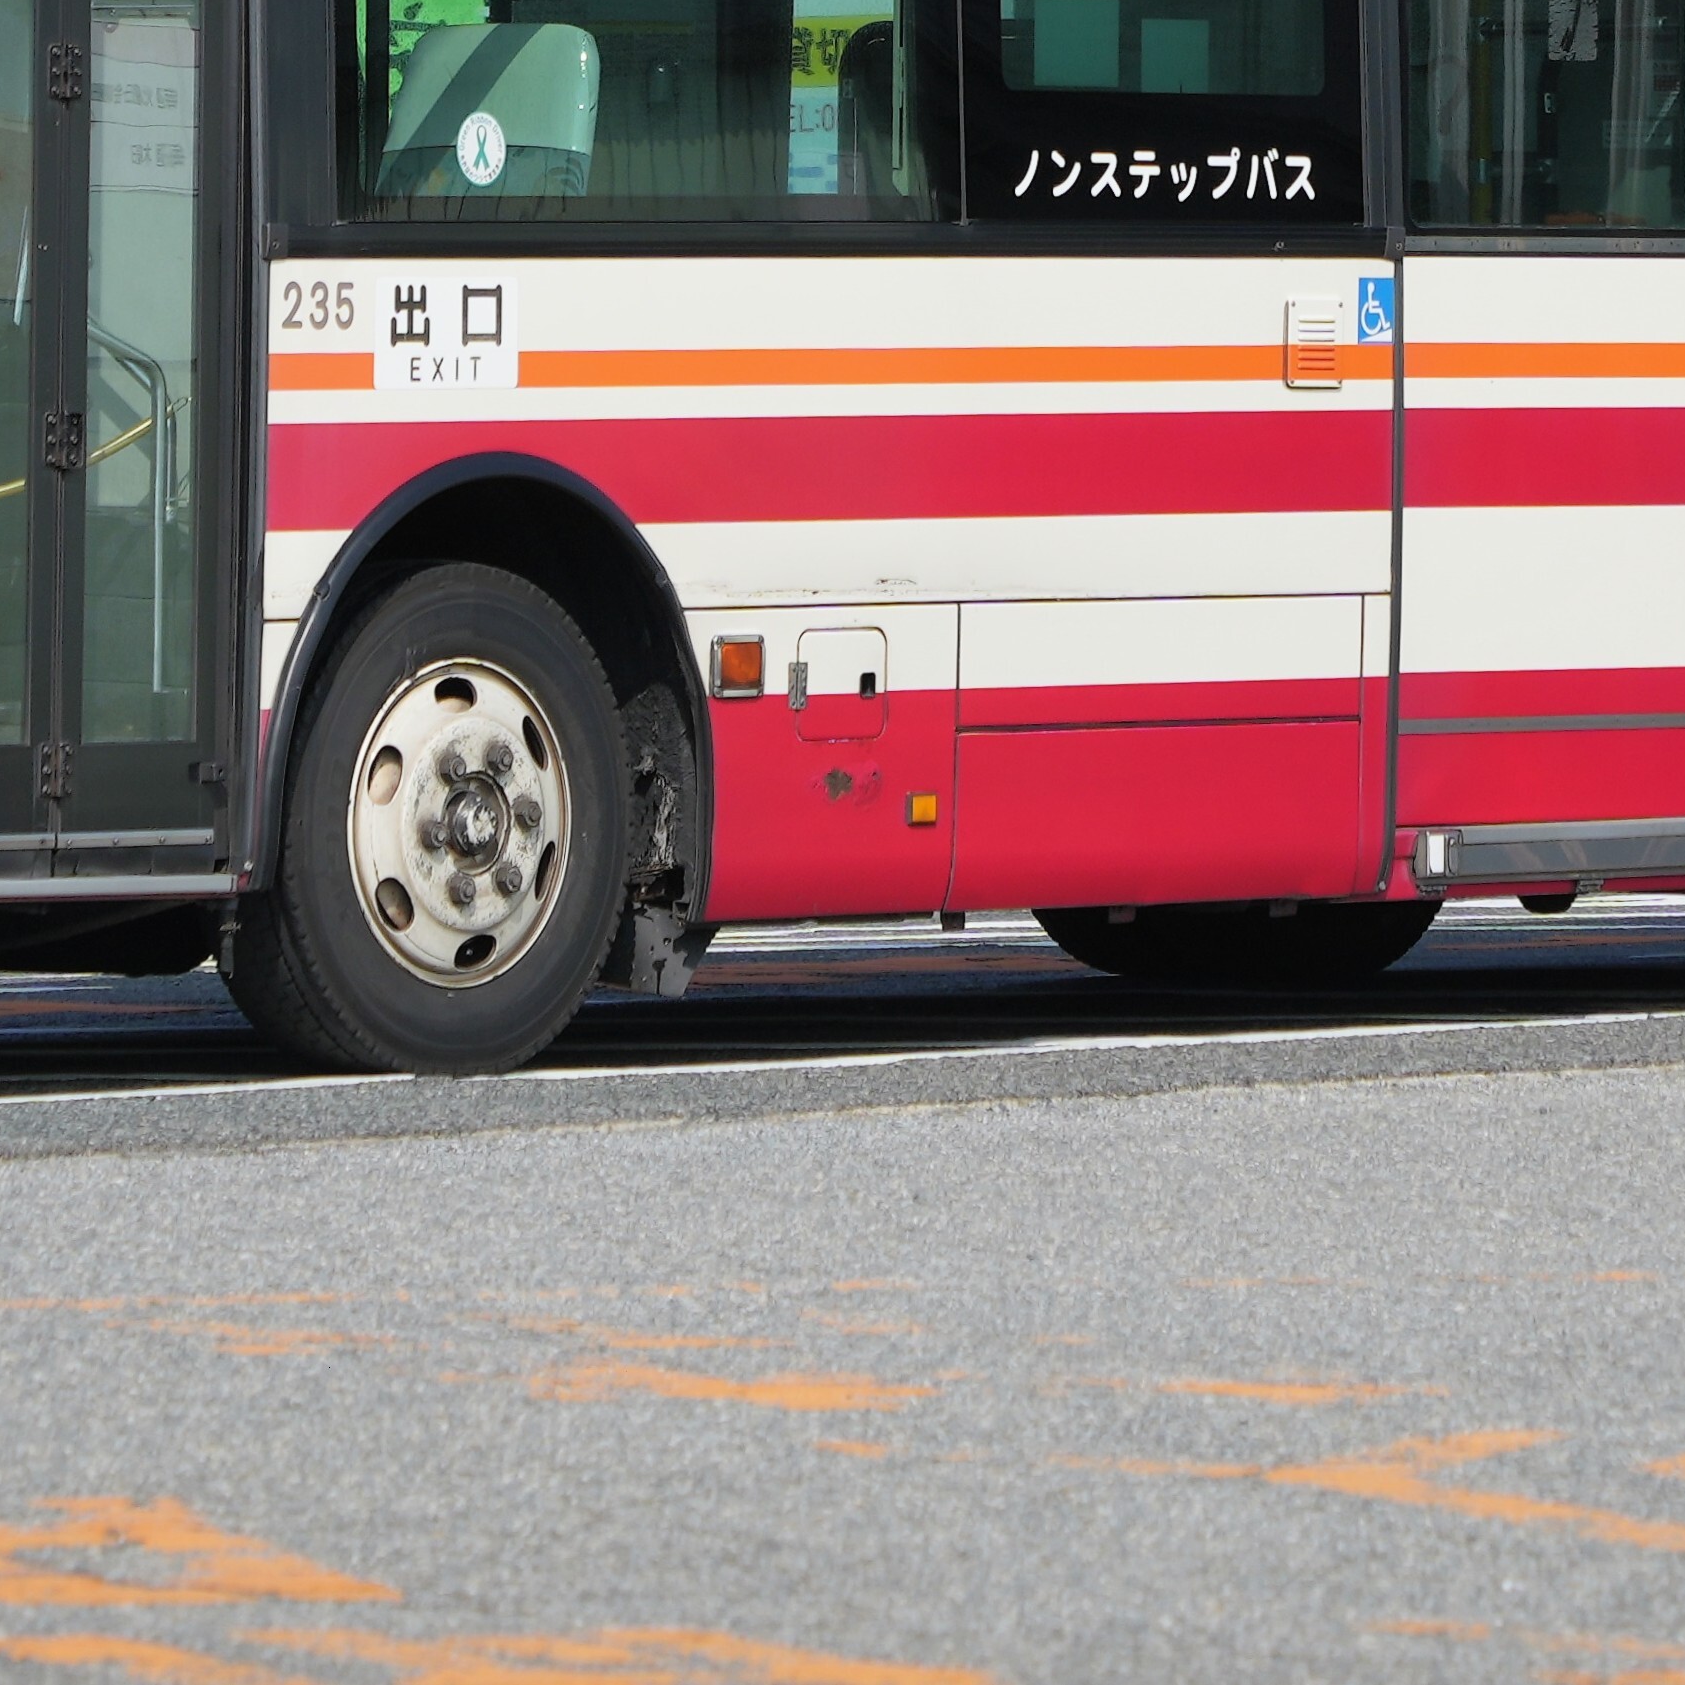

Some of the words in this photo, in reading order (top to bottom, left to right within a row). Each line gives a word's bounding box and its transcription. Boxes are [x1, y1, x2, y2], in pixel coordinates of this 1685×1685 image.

[1013, 147, 1317, 204] ノンステップバス
[281, 280, 355, 331] 235
[390, 283, 503, 347] 出口
[409, 356, 482, 384] EXIT
